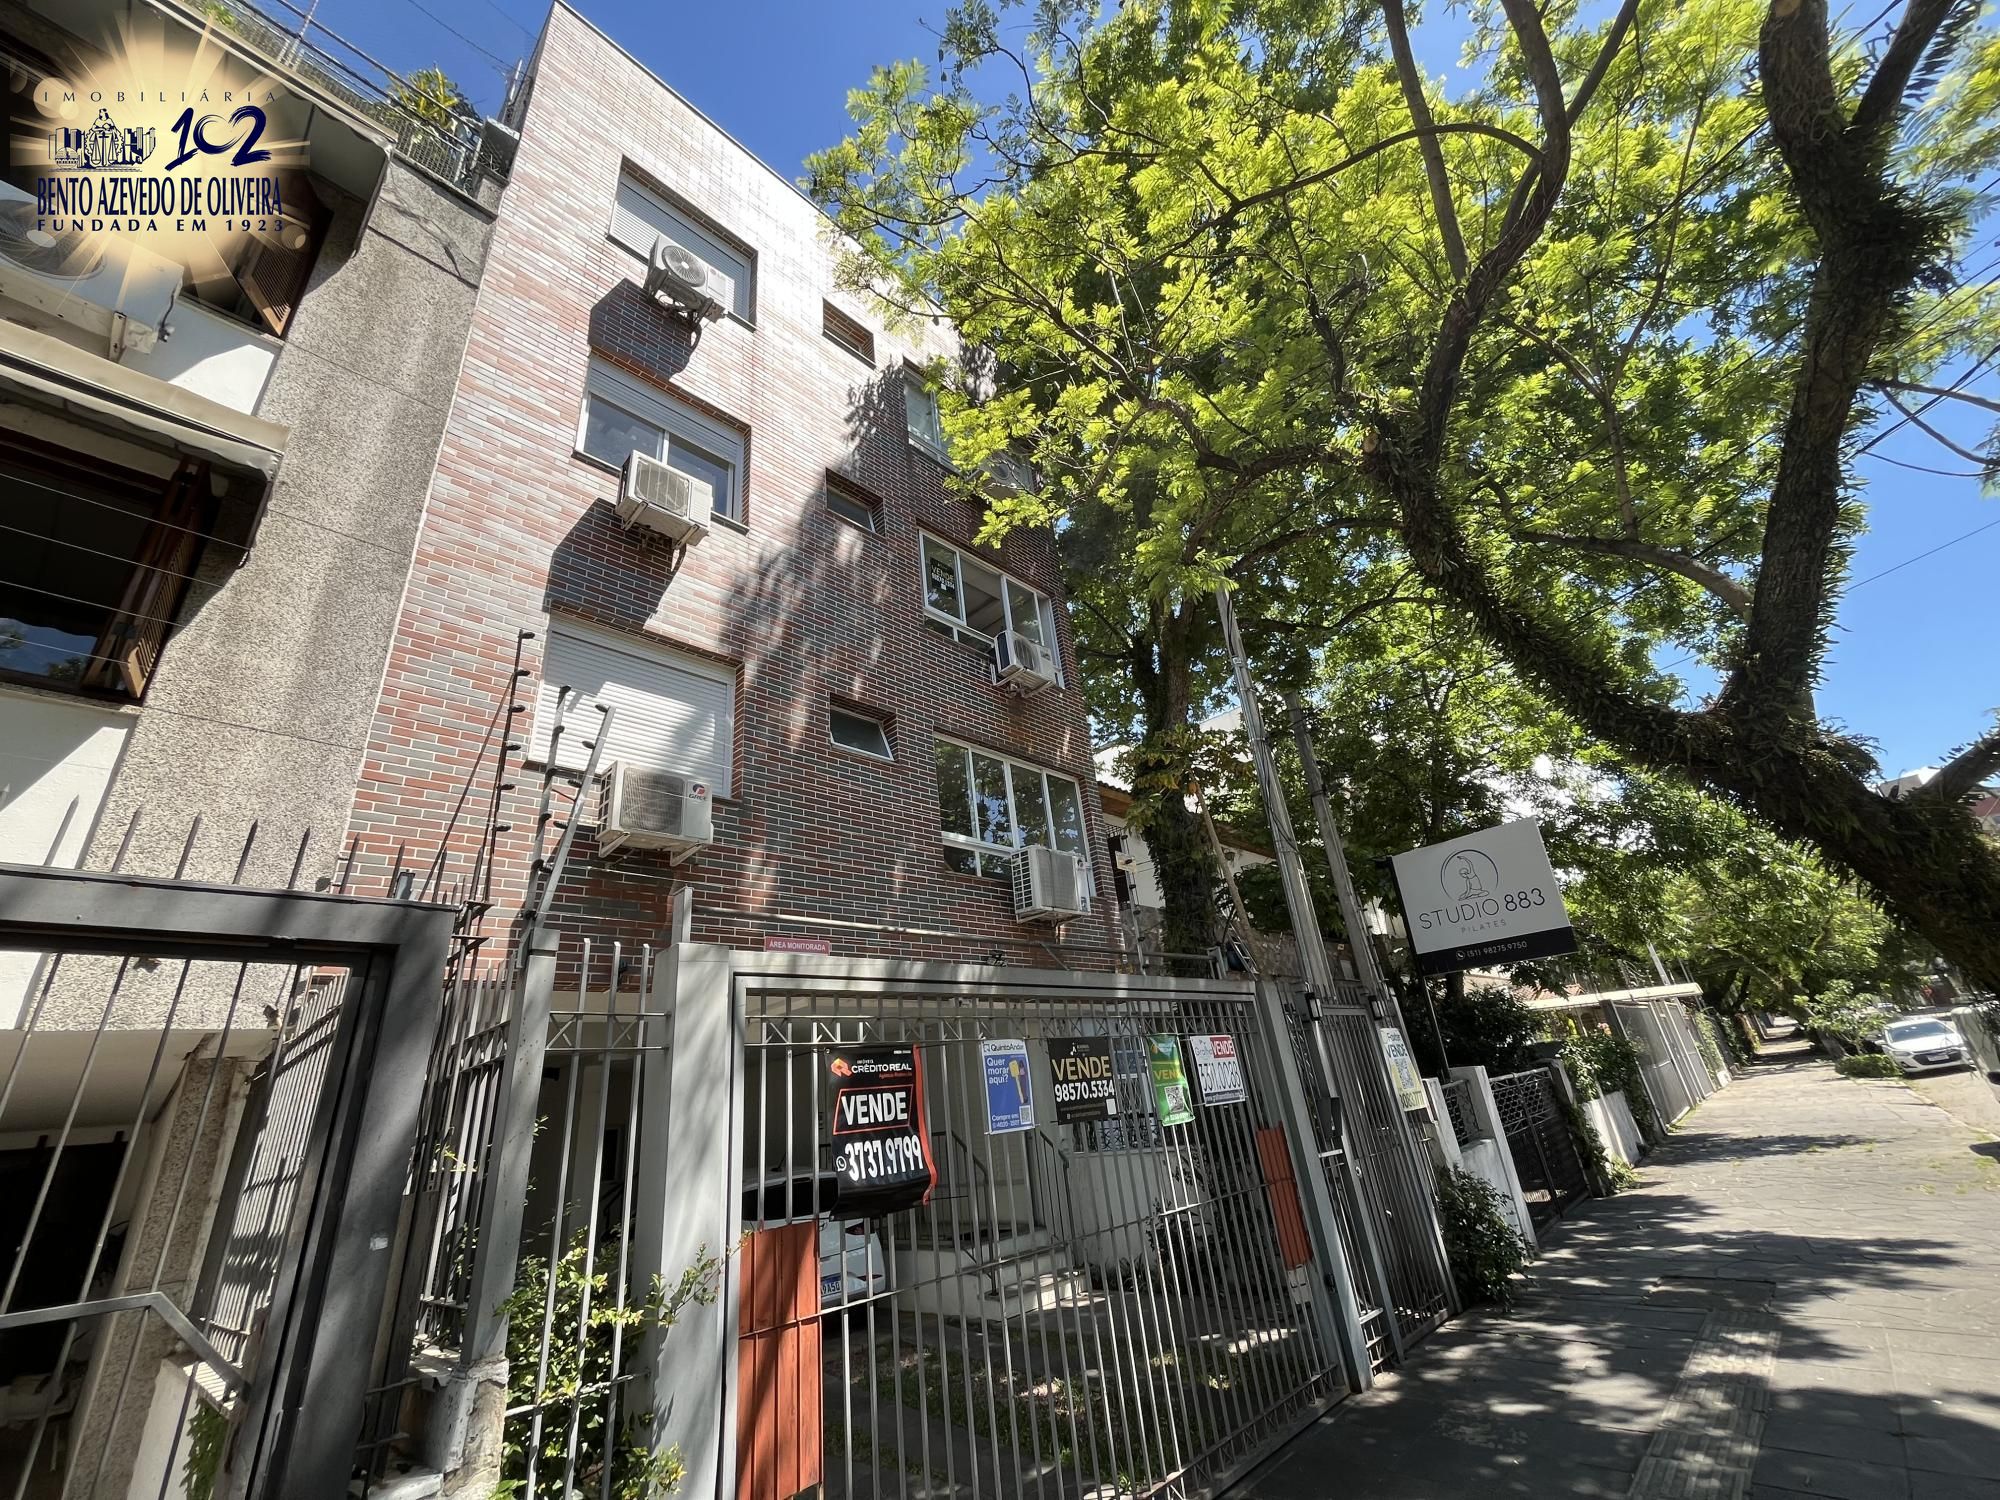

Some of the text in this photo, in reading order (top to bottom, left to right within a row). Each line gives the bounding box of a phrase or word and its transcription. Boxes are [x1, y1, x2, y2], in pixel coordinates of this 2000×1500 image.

[1419, 887, 1546, 930] STUDIO 883
[1461, 918, 1507, 934] PILATES
[769, 939, 826, 951] ÁREA MONITORADA
[1212, 1040, 1235, 1056] VENDE
[851, 1062, 913, 1074] CRÉDITO REAL
[986, 1057, 1006, 1067] Quer
[1052, 1056, 1112, 1081] VENDE
[987, 1067, 1010, 1076] morar
[988, 1074, 1009, 1086] aqui?
[1054, 1079, 1116, 1103] 98570.5334
[841, 1091, 908, 1126] VENDE
[844, 1134, 924, 1182] 3737.9799
